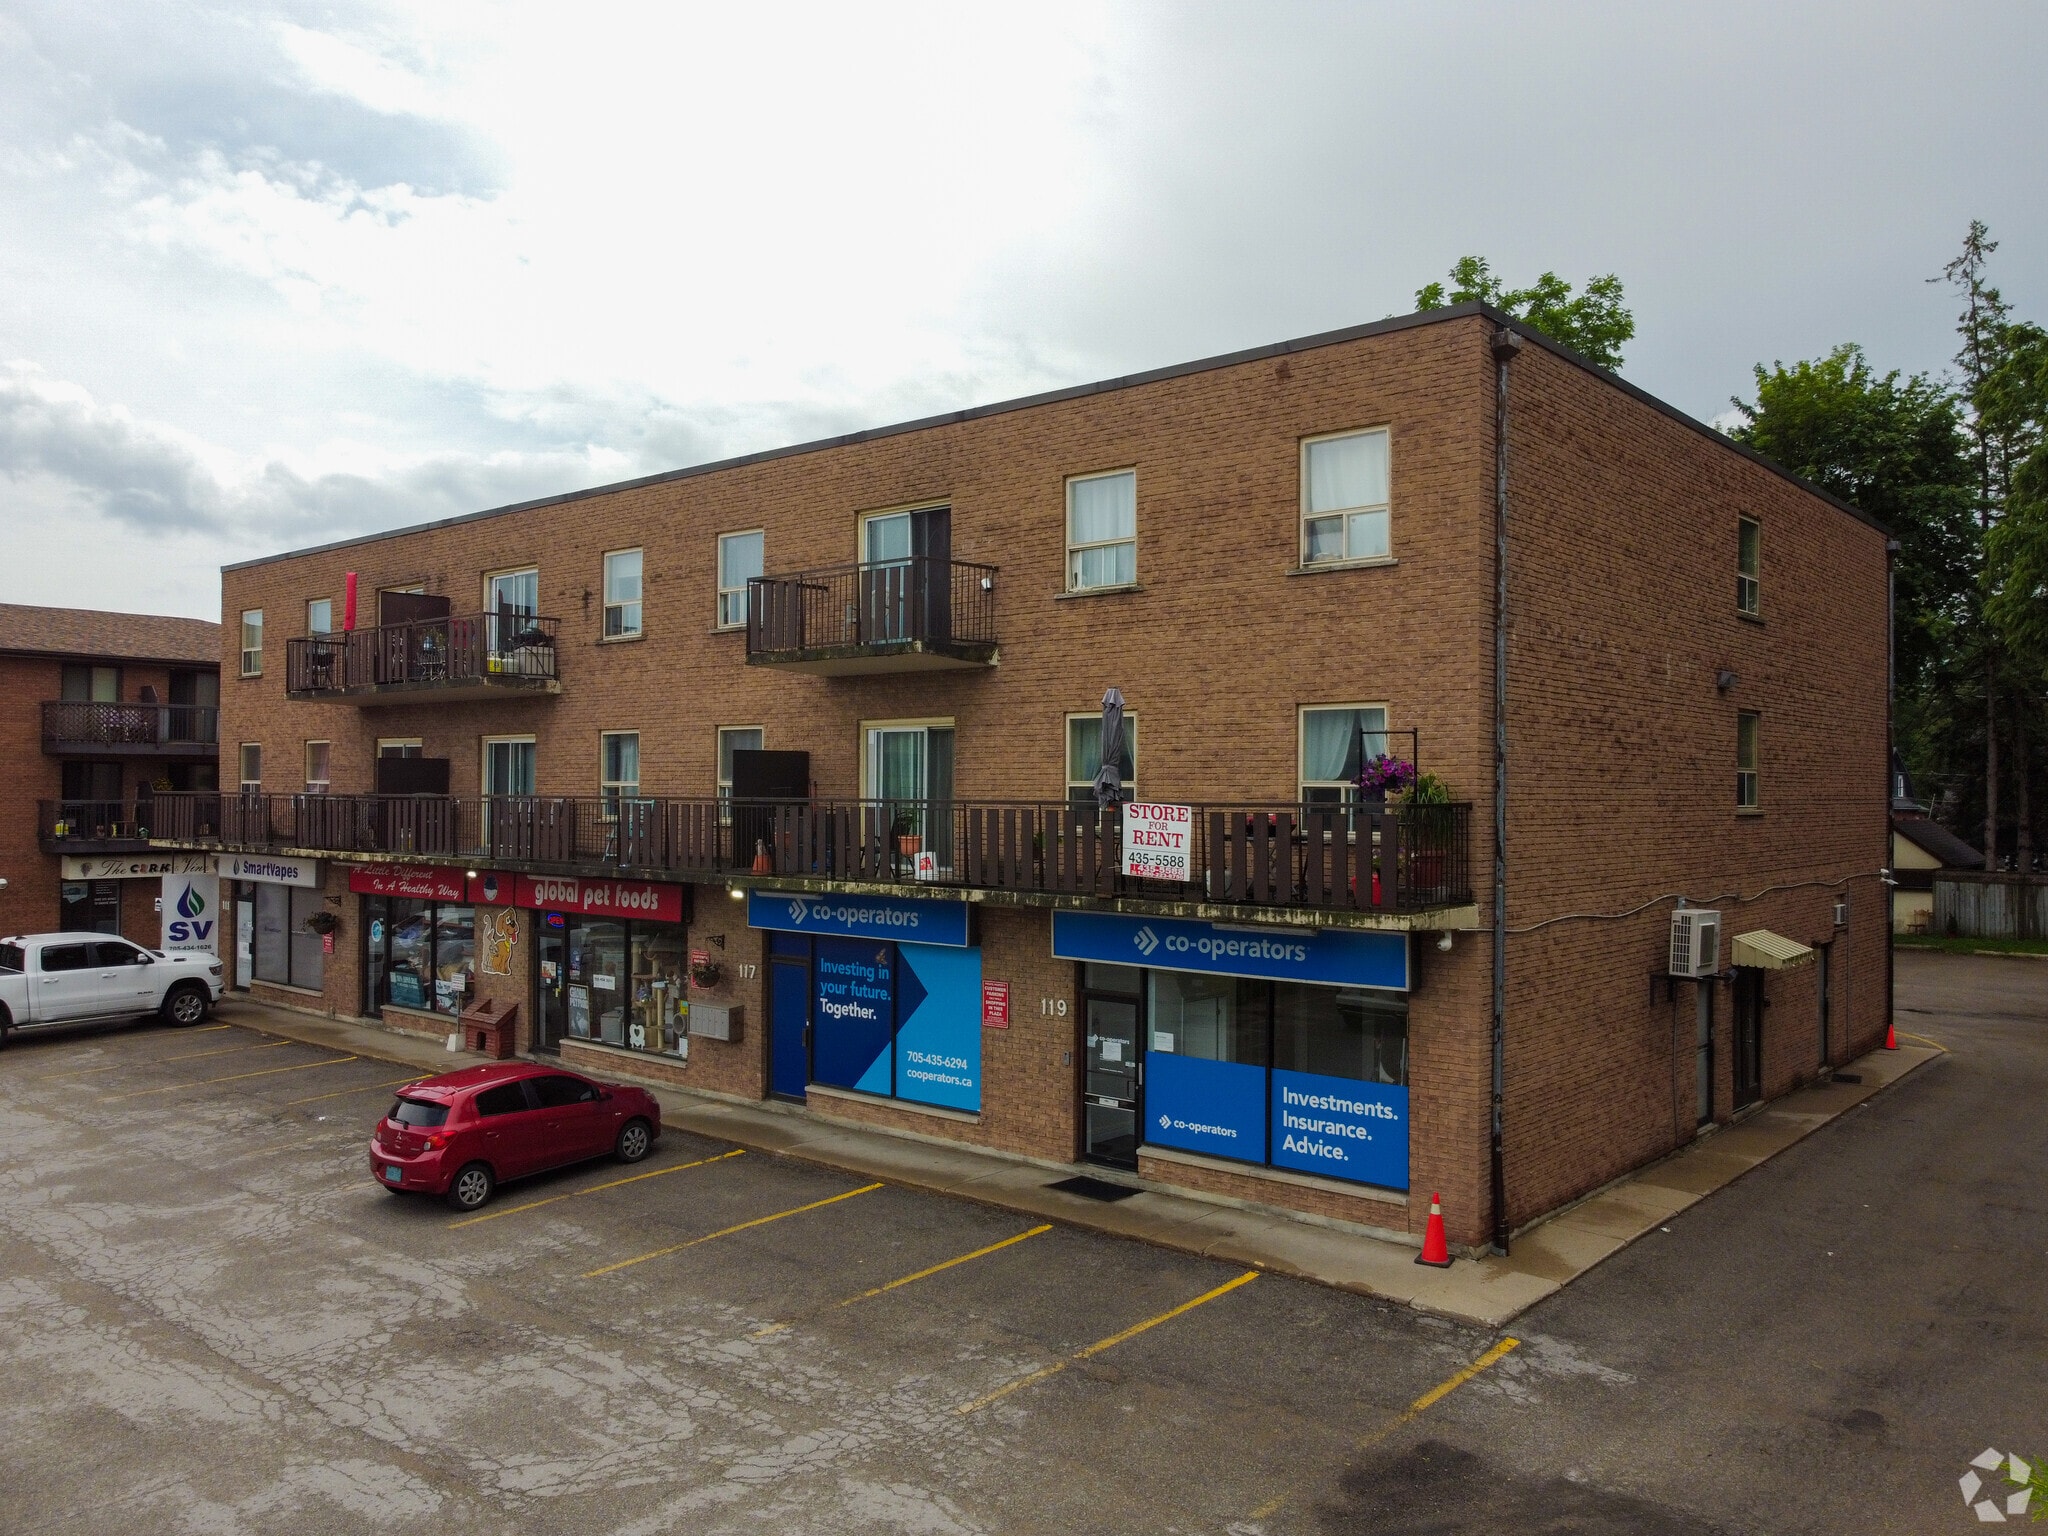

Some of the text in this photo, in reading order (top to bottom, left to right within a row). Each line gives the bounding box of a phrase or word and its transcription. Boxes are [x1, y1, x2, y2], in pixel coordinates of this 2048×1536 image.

[1129, 804, 1189, 823] STORE
[1148, 821, 1168, 831] FOR
[1132, 829, 1184, 849] RENT
[97, 859, 128, 877] The
[243, 860, 299, 880] SmartVapes
[1128, 852, 1184, 868] 435-5588
[364, 864, 391, 876] Little
[393, 865, 434, 881] Different
[373, 879, 460, 899] In A Healthy Way
[534, 879, 659, 910] global pet foods
[812, 902, 919, 928] co-operators
[168, 920, 214, 942] SV
[1165, 935, 1306, 962] co-operators
[739, 963, 756, 979] 117
[820, 957, 890, 982] Investing in
[820, 980, 891, 1001] your future.
[820, 997, 877, 1020] Together.
[1041, 998, 1068, 1017] 119
[907, 1050, 968, 1070] 705-435-6294
[907, 1069, 972, 1087] cooperators.ca
[1283, 1086, 1399, 1121] Investments.
[1173, 1119, 1238, 1138] co-operators
[1283, 1110, 1373, 1141] Insurance.
[1282, 1134, 1349, 1161] Advice.
